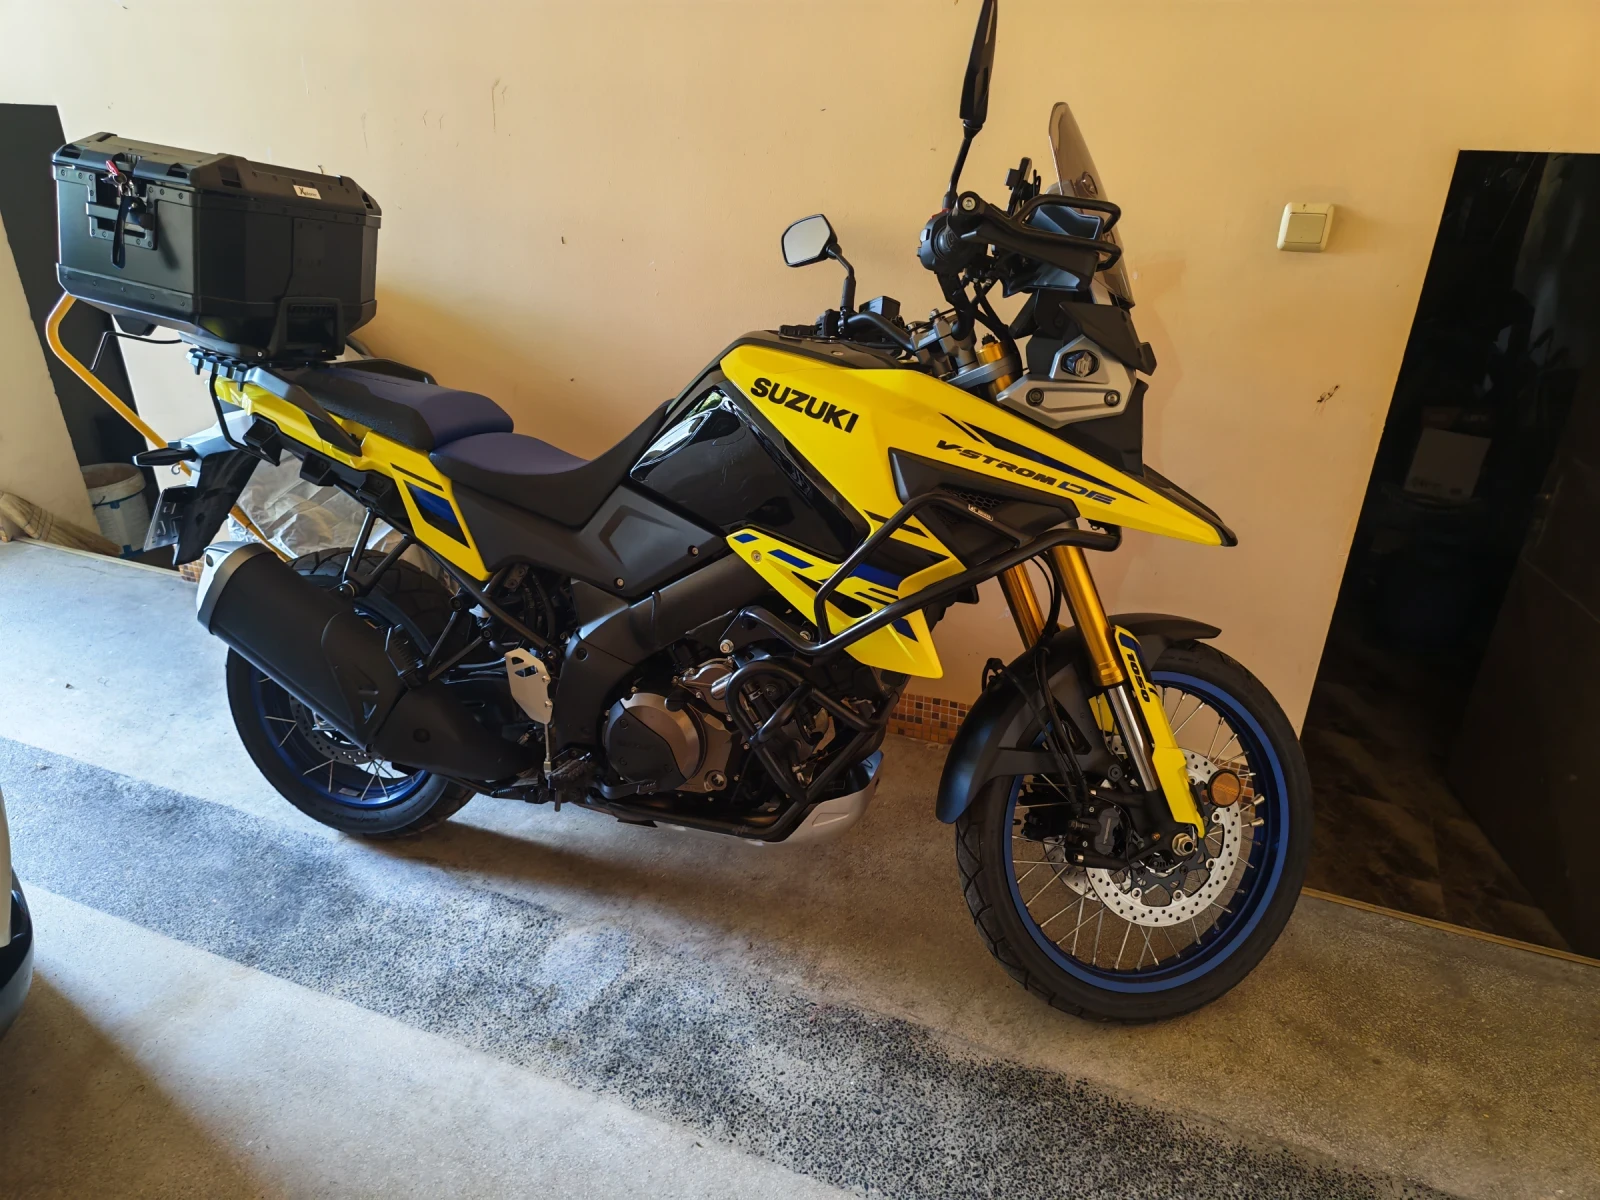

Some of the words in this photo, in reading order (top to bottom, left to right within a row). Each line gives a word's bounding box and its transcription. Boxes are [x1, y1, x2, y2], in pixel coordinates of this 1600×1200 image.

[751, 378, 858, 433] SUZUKI
[936, 440, 1058, 486] V-STROM
[1056, 481, 1117, 505] DE
[1126, 653, 1151, 703] 1050
